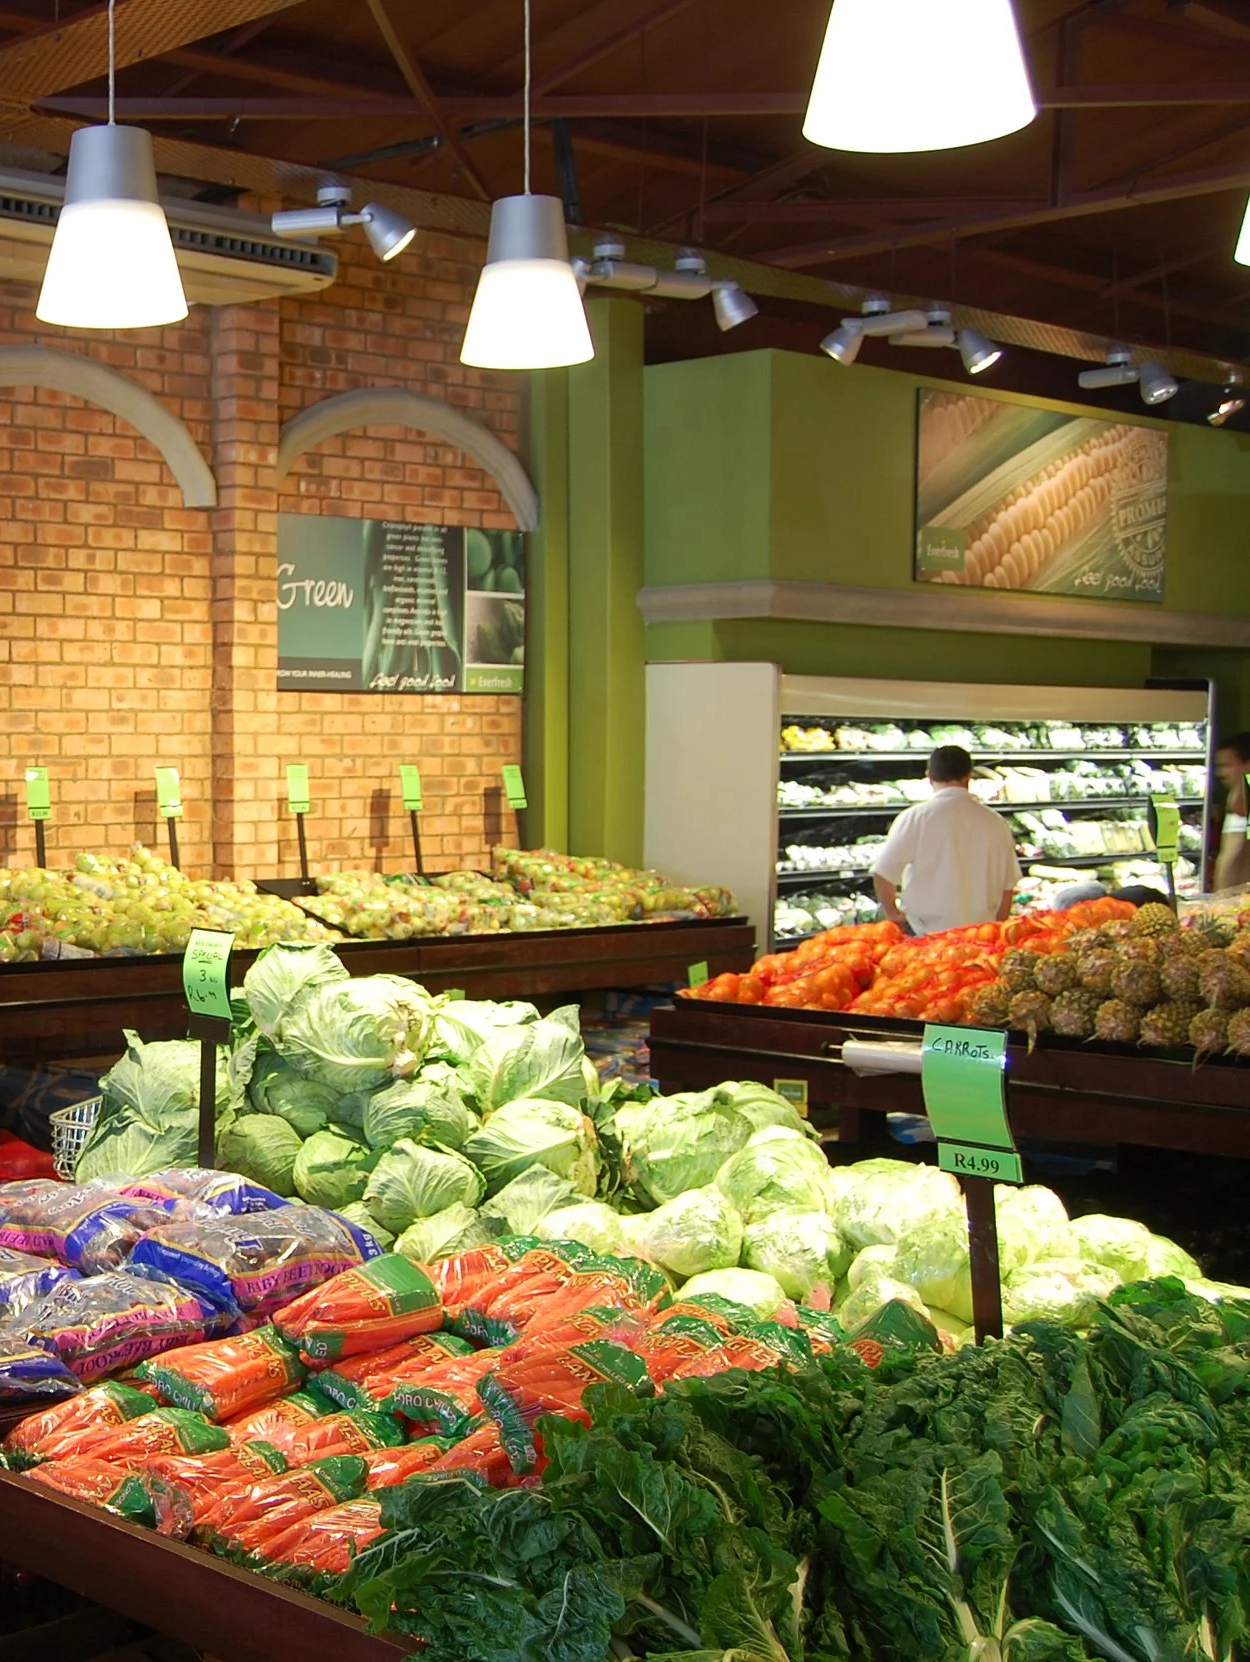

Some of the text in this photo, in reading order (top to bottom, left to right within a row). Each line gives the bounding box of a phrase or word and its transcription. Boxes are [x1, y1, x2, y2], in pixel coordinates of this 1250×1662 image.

[278, 563, 353, 610] Green
[398, 673, 428, 690] good
[429, 674, 456, 689] food
[478, 677, 513, 689] Everfresh
[199, 969, 207, 982] 3
[954, 1151, 1000, 1174] R4.99
[246, 1276, 280, 1294] BABY
